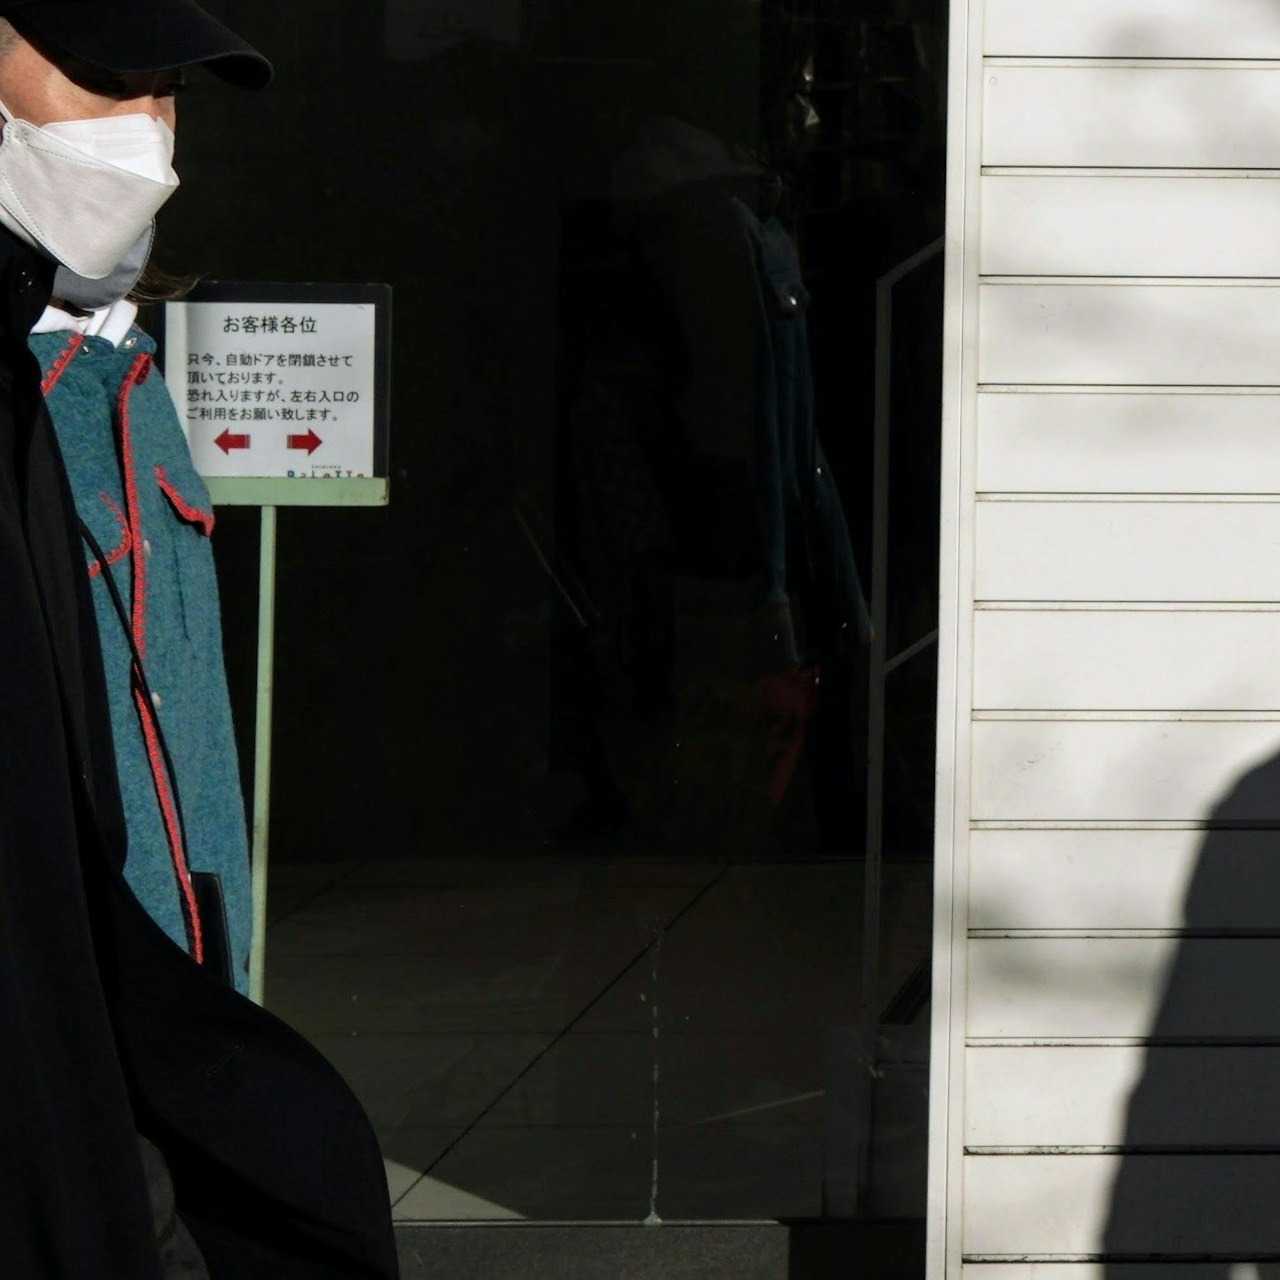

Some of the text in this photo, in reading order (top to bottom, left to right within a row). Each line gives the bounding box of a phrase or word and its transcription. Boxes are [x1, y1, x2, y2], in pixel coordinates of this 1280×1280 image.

[223, 316, 317, 334] お客様各位
[187, 353, 353, 367] 只今、自動ドアを閉鎖させて
[187, 371, 283, 385] 頂いております。
[186, 389, 359, 403] 恐れ入りますが、左右入口の
[186, 407, 338, 422] ご利用をお願い致します。
